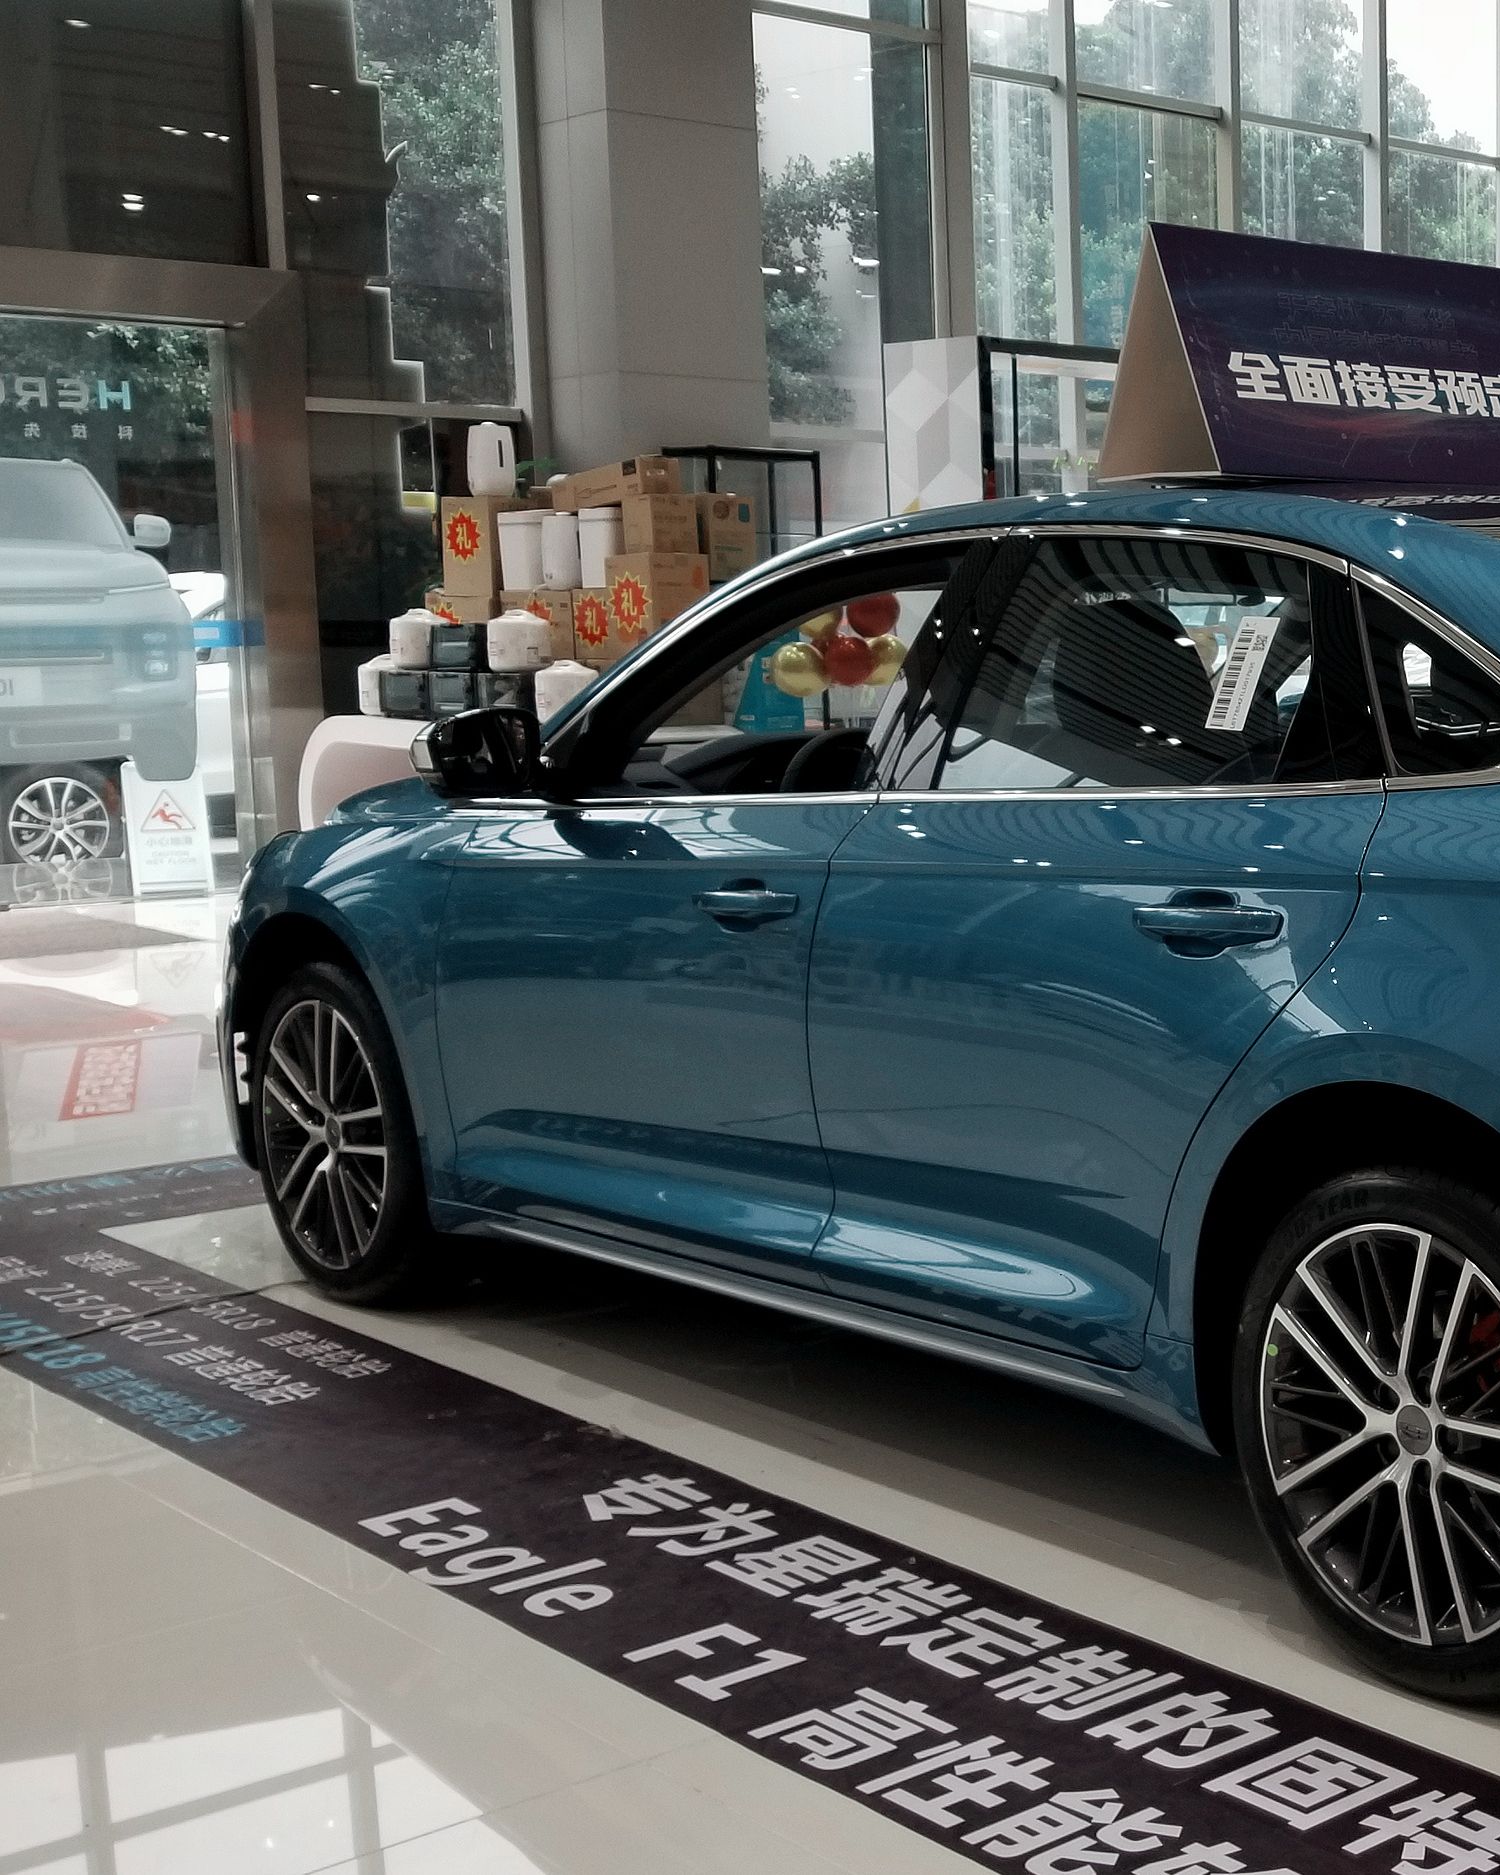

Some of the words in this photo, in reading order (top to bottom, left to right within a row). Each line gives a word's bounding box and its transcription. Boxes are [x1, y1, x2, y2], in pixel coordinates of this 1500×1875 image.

[455, 523, 472, 550] 礼
[621, 589, 638, 617] 礼
[584, 609, 600, 639] 礼
[358, 1497, 614, 1617] Eagle
[622, 1622, 808, 1702] F1
